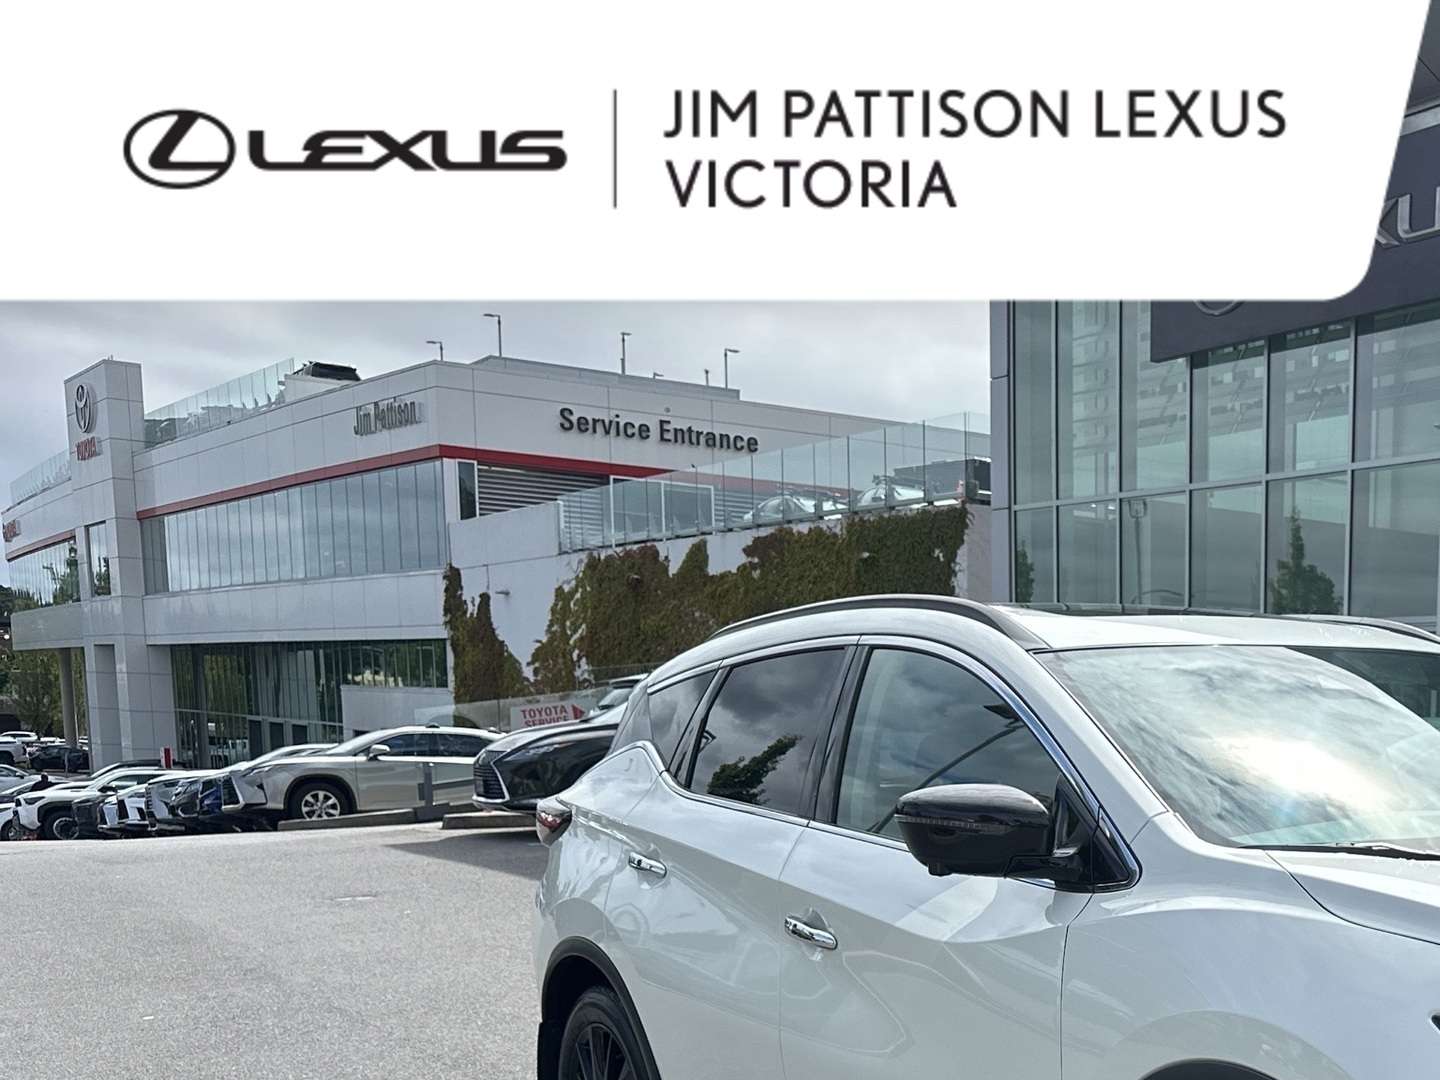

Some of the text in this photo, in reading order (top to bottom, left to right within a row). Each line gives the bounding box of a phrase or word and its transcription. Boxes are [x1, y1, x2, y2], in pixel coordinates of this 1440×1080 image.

[559, 407, 759, 453] Service Entrance
[521, 704, 568, 719] TOYOTA
